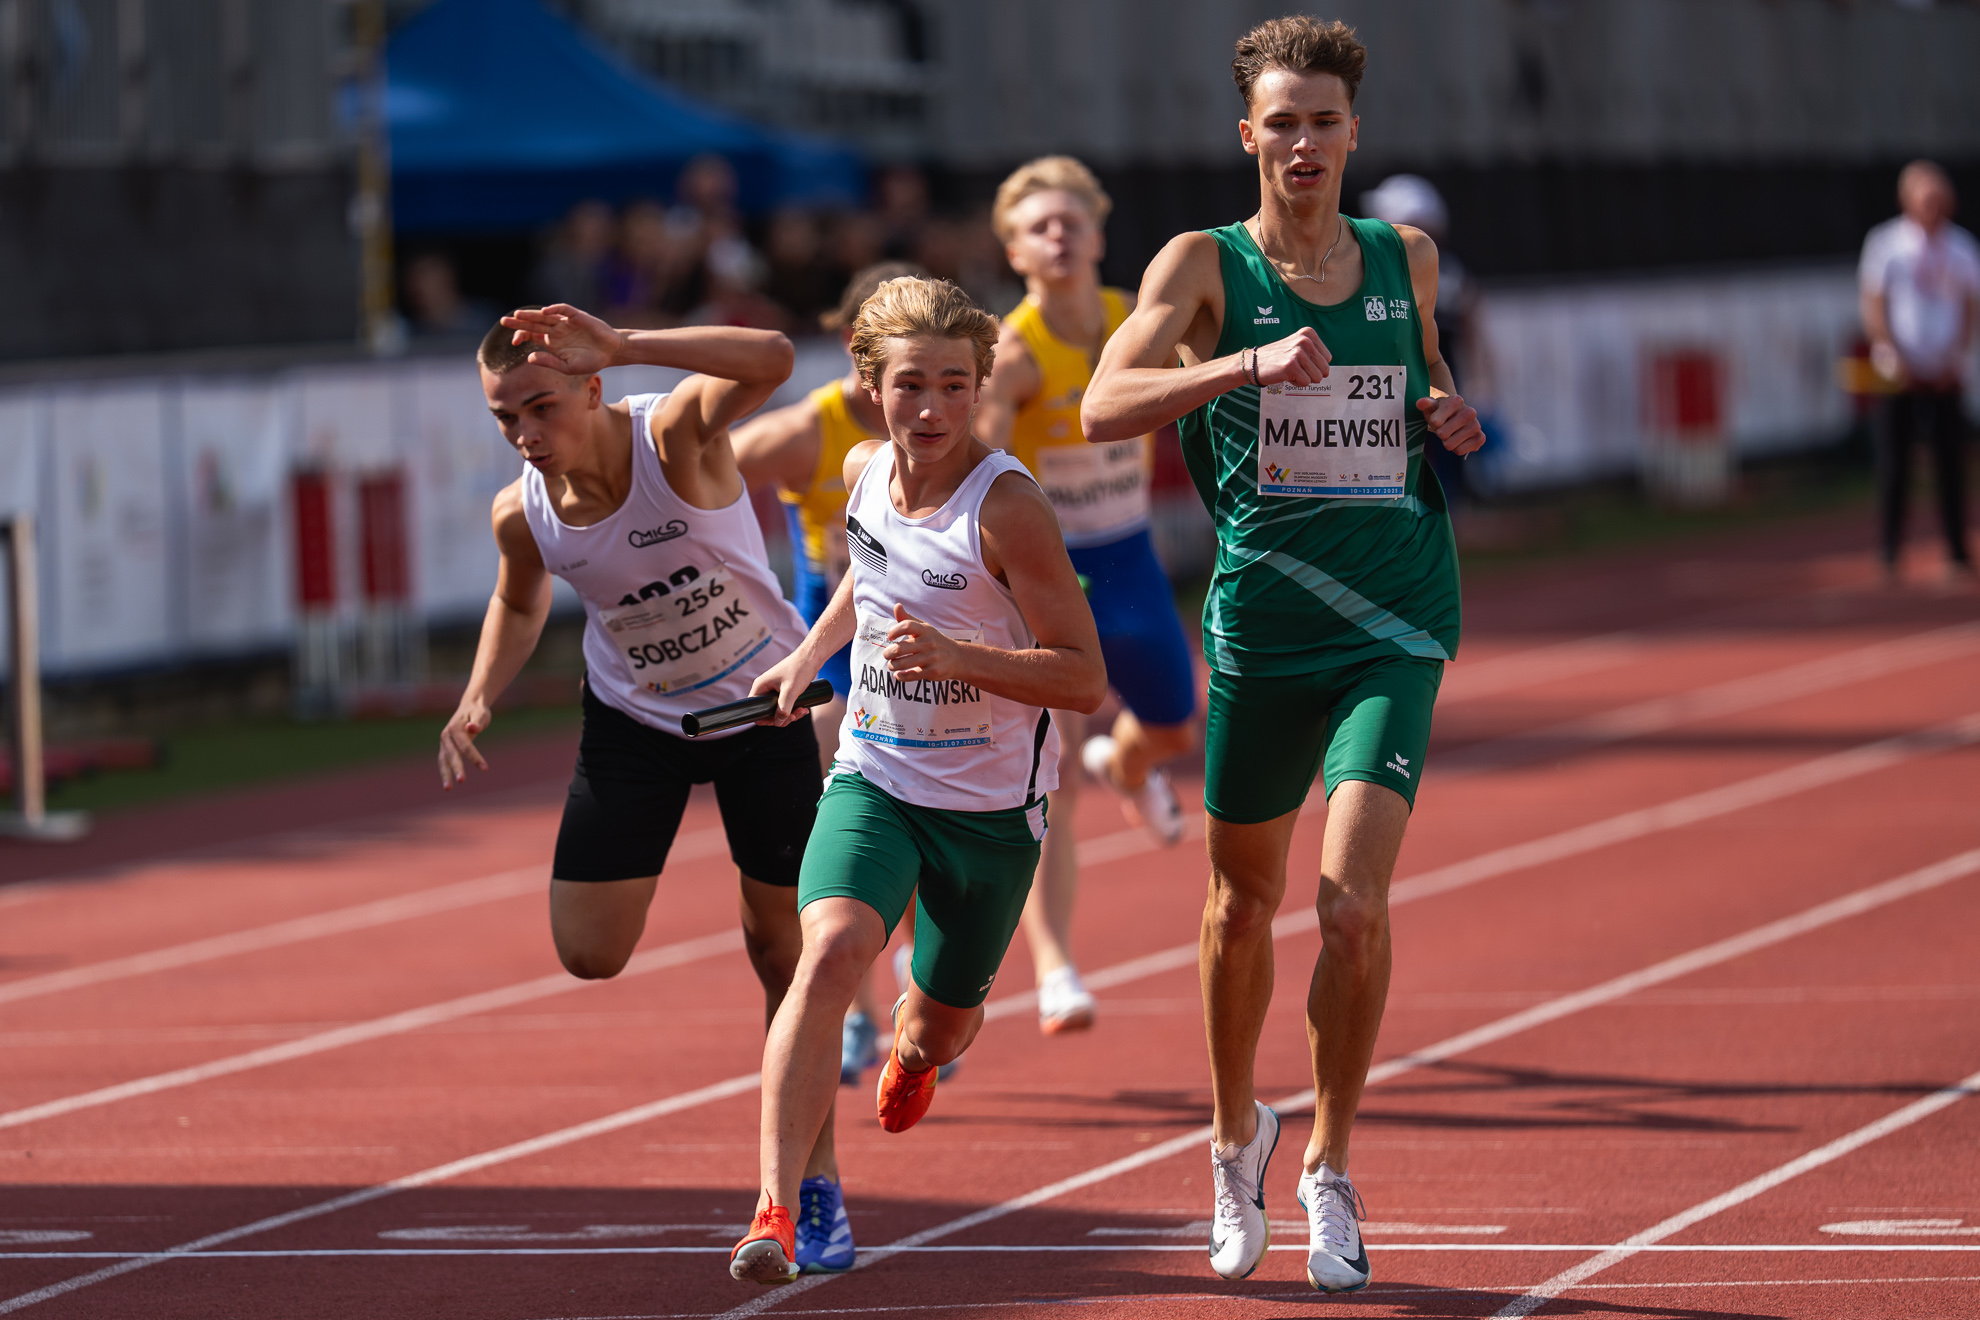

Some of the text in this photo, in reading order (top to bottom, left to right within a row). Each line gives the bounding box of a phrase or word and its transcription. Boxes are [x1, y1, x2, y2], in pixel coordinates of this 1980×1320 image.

[1253, 317, 1280, 325] erima
[1308, 384, 1332, 392] Turystyki
[1347, 374, 1396, 400] 231
[1265, 418, 1401, 447] MAJEWSKI
[1281, 486, 1313, 494] POZNAŃ
[674, 577, 725, 617] 256
[627, 598, 750, 670] SOBCZAK
[858, 663, 981, 705] ADAMCZEWSKI
[865, 733, 895, 744] POZNAŃ
[1386, 761, 1410, 779] erima
